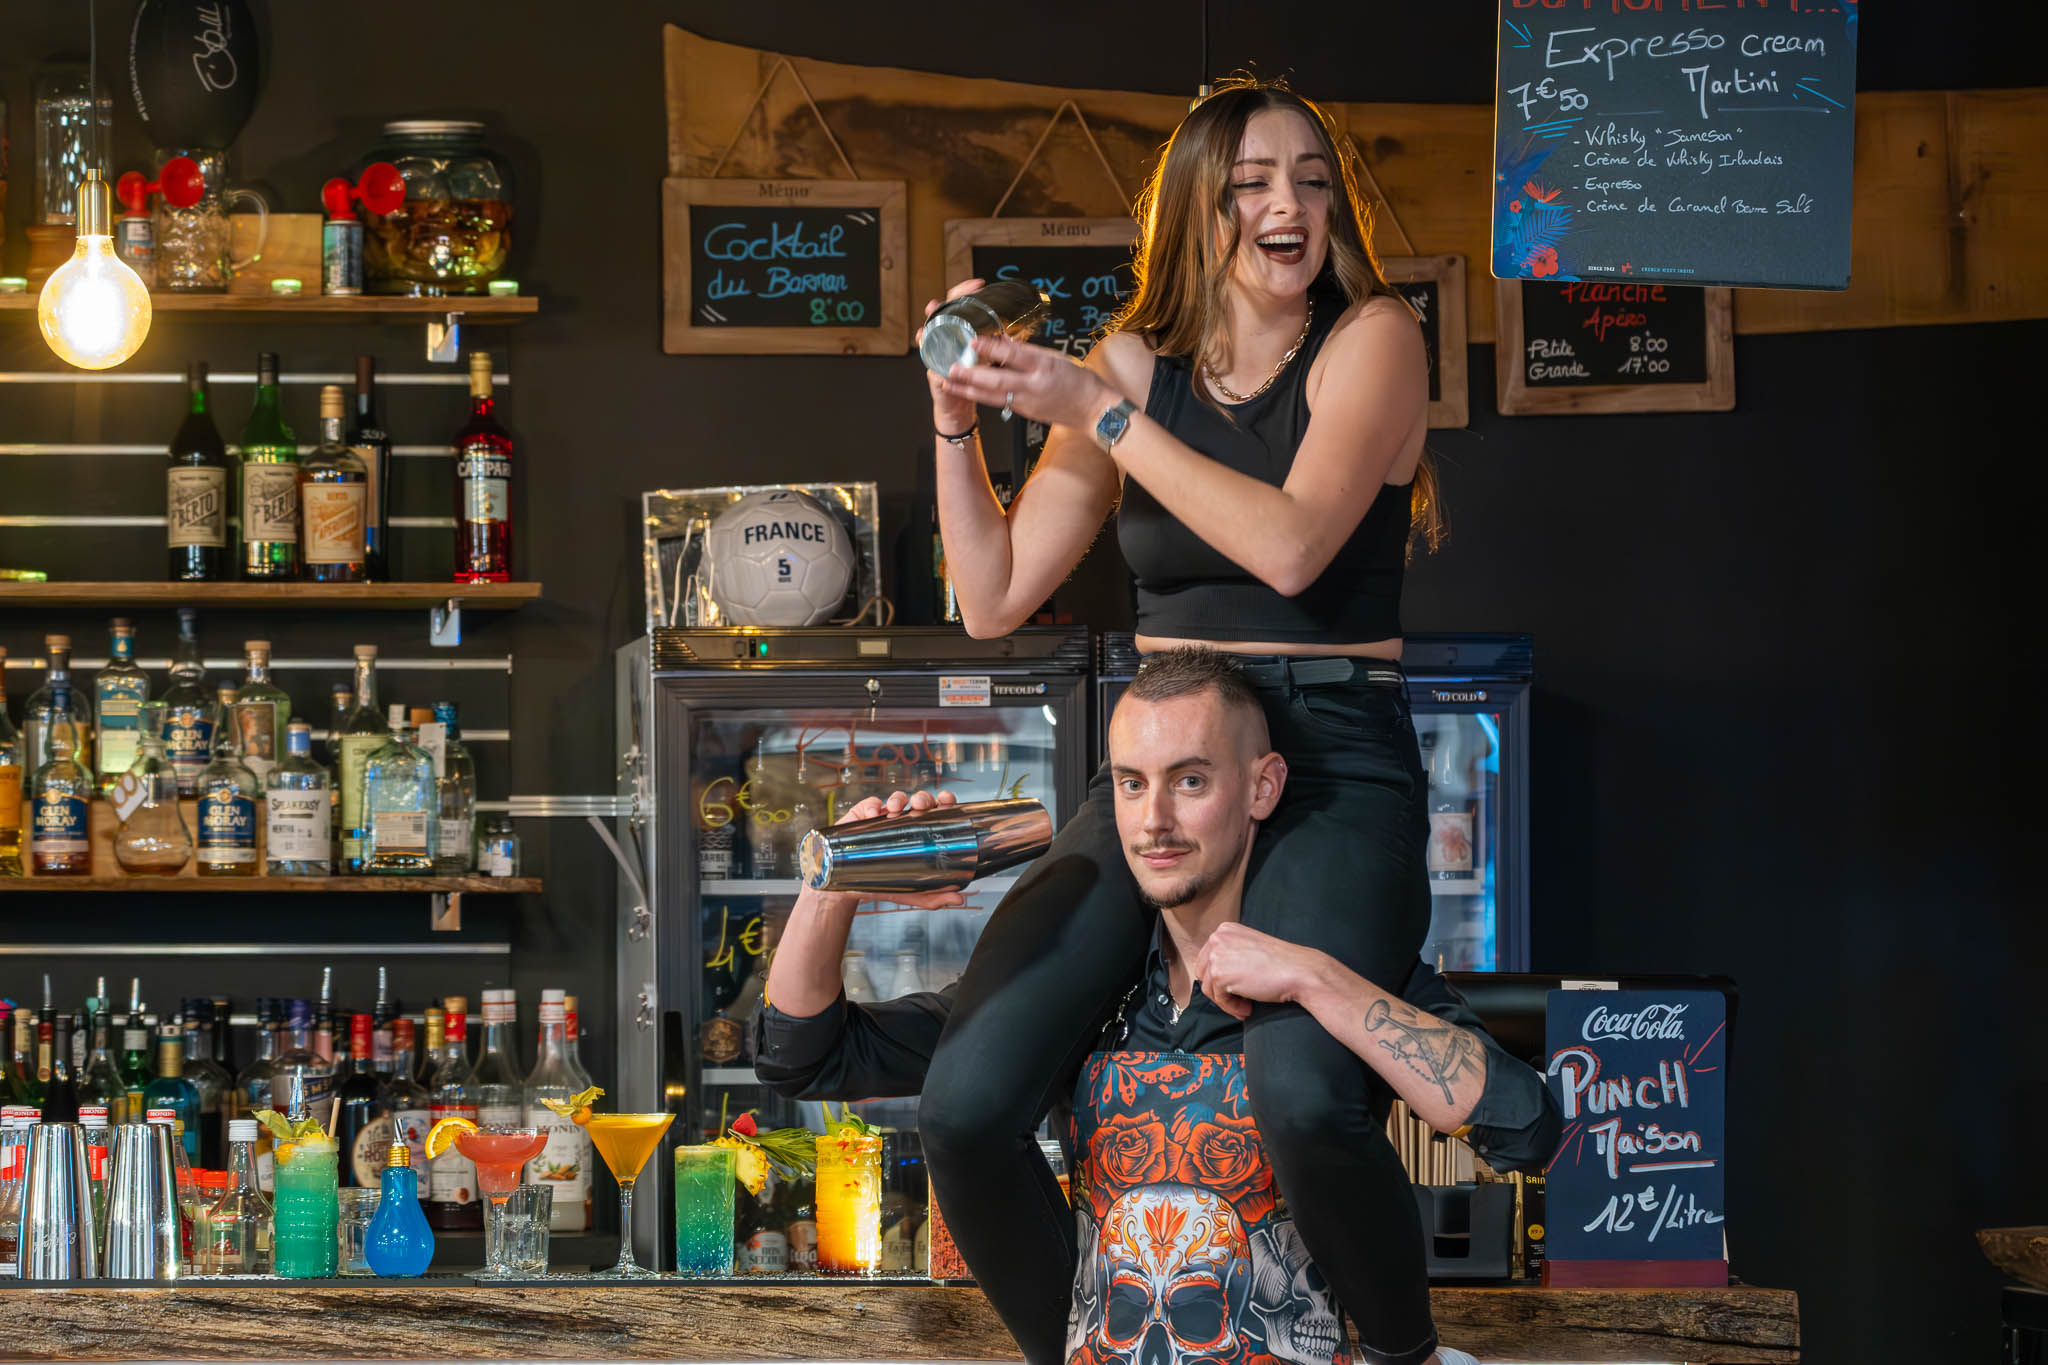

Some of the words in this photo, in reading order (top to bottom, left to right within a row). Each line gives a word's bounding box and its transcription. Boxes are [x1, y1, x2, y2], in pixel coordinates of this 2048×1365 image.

[1545, 27, 1725, 81] Expresso
[1681, 65, 1780, 119] Martini
[1585, 122, 1646, 153] Whisky
[1584, 151, 1630, 168] Crème
[1637, 149, 1657, 167] de
[1666, 149, 1713, 174] Whisky
[1718, 149, 1784, 168] Irlandais
[759, 183, 810, 198] Mémo
[1584, 177, 1642, 196] Expresso
[1637, 197, 1657, 213] de
[1668, 195, 1727, 214] Caramel
[1041, 222, 1091, 237] Mémo
[704, 220, 847, 261] Cocktail
[707, 268, 750, 300] du
[757, 266, 848, 298] Barman
[1082, 275, 1128, 298] on
[1582, 306, 1647, 342] Apéro
[1528, 338, 1575, 359] Petite
[1529, 362, 1591, 380] Grande
[744, 522, 825, 545] FRANCE
[778, 559, 791, 576] 5
[994, 686, 1034, 694] TEFCOLD
[171, 730, 202, 740] GLEN
[40, 806, 70, 816] GLEN
[204, 816, 247, 826] MORAY
[209, 806, 240, 816] GLEN
[1582, 1004, 1689, 1041] Coca-Cola
[1588, 1117, 1702, 1180] Maison
